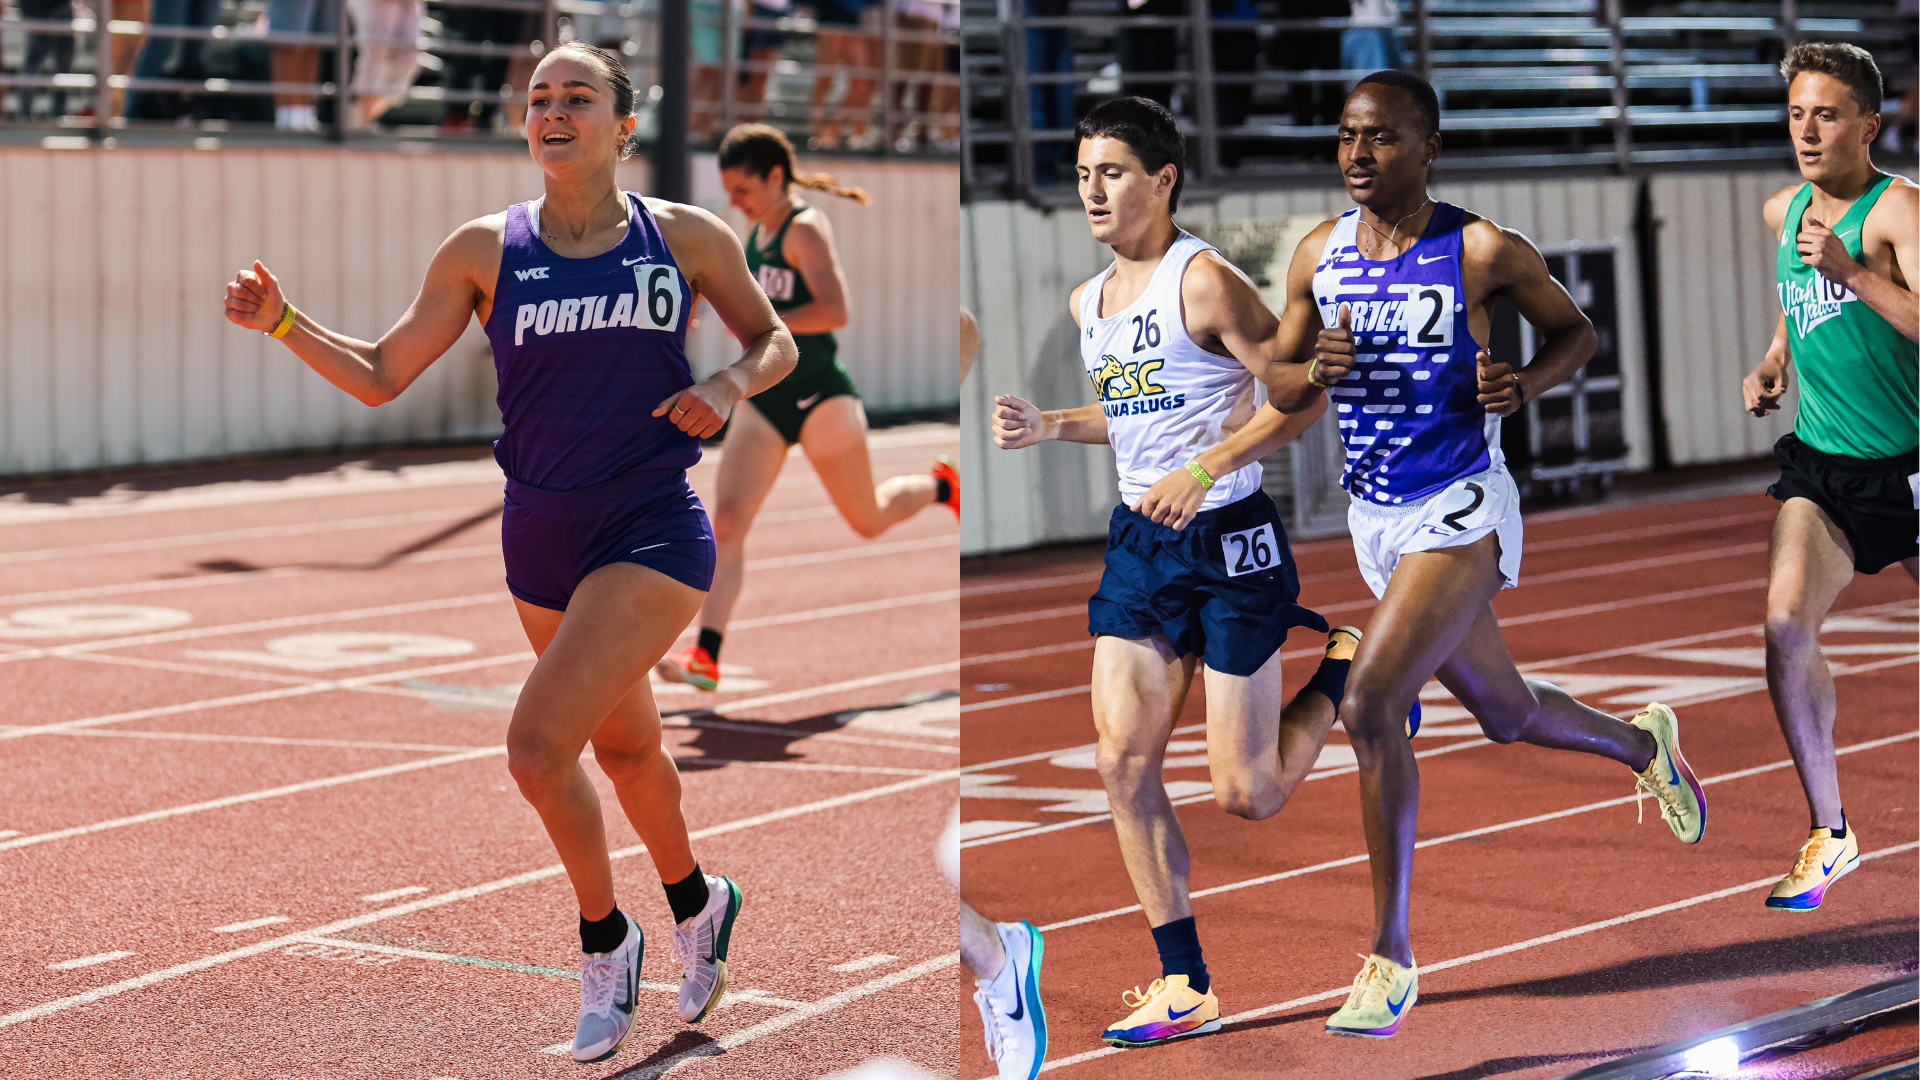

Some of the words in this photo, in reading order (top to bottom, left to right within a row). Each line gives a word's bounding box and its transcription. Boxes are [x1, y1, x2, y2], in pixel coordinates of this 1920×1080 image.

[514, 267, 550, 282] WCC
[648, 267, 674, 327] 6
[1777, 277, 1817, 316] Utah
[515, 293, 638, 346] PORTLA
[1132, 309, 1161, 354] 26
[1417, 289, 1445, 343] 2
[1131, 393, 1186, 416] SLUGS
[1442, 482, 1485, 532] 2
[1229, 528, 1272, 574] 26
